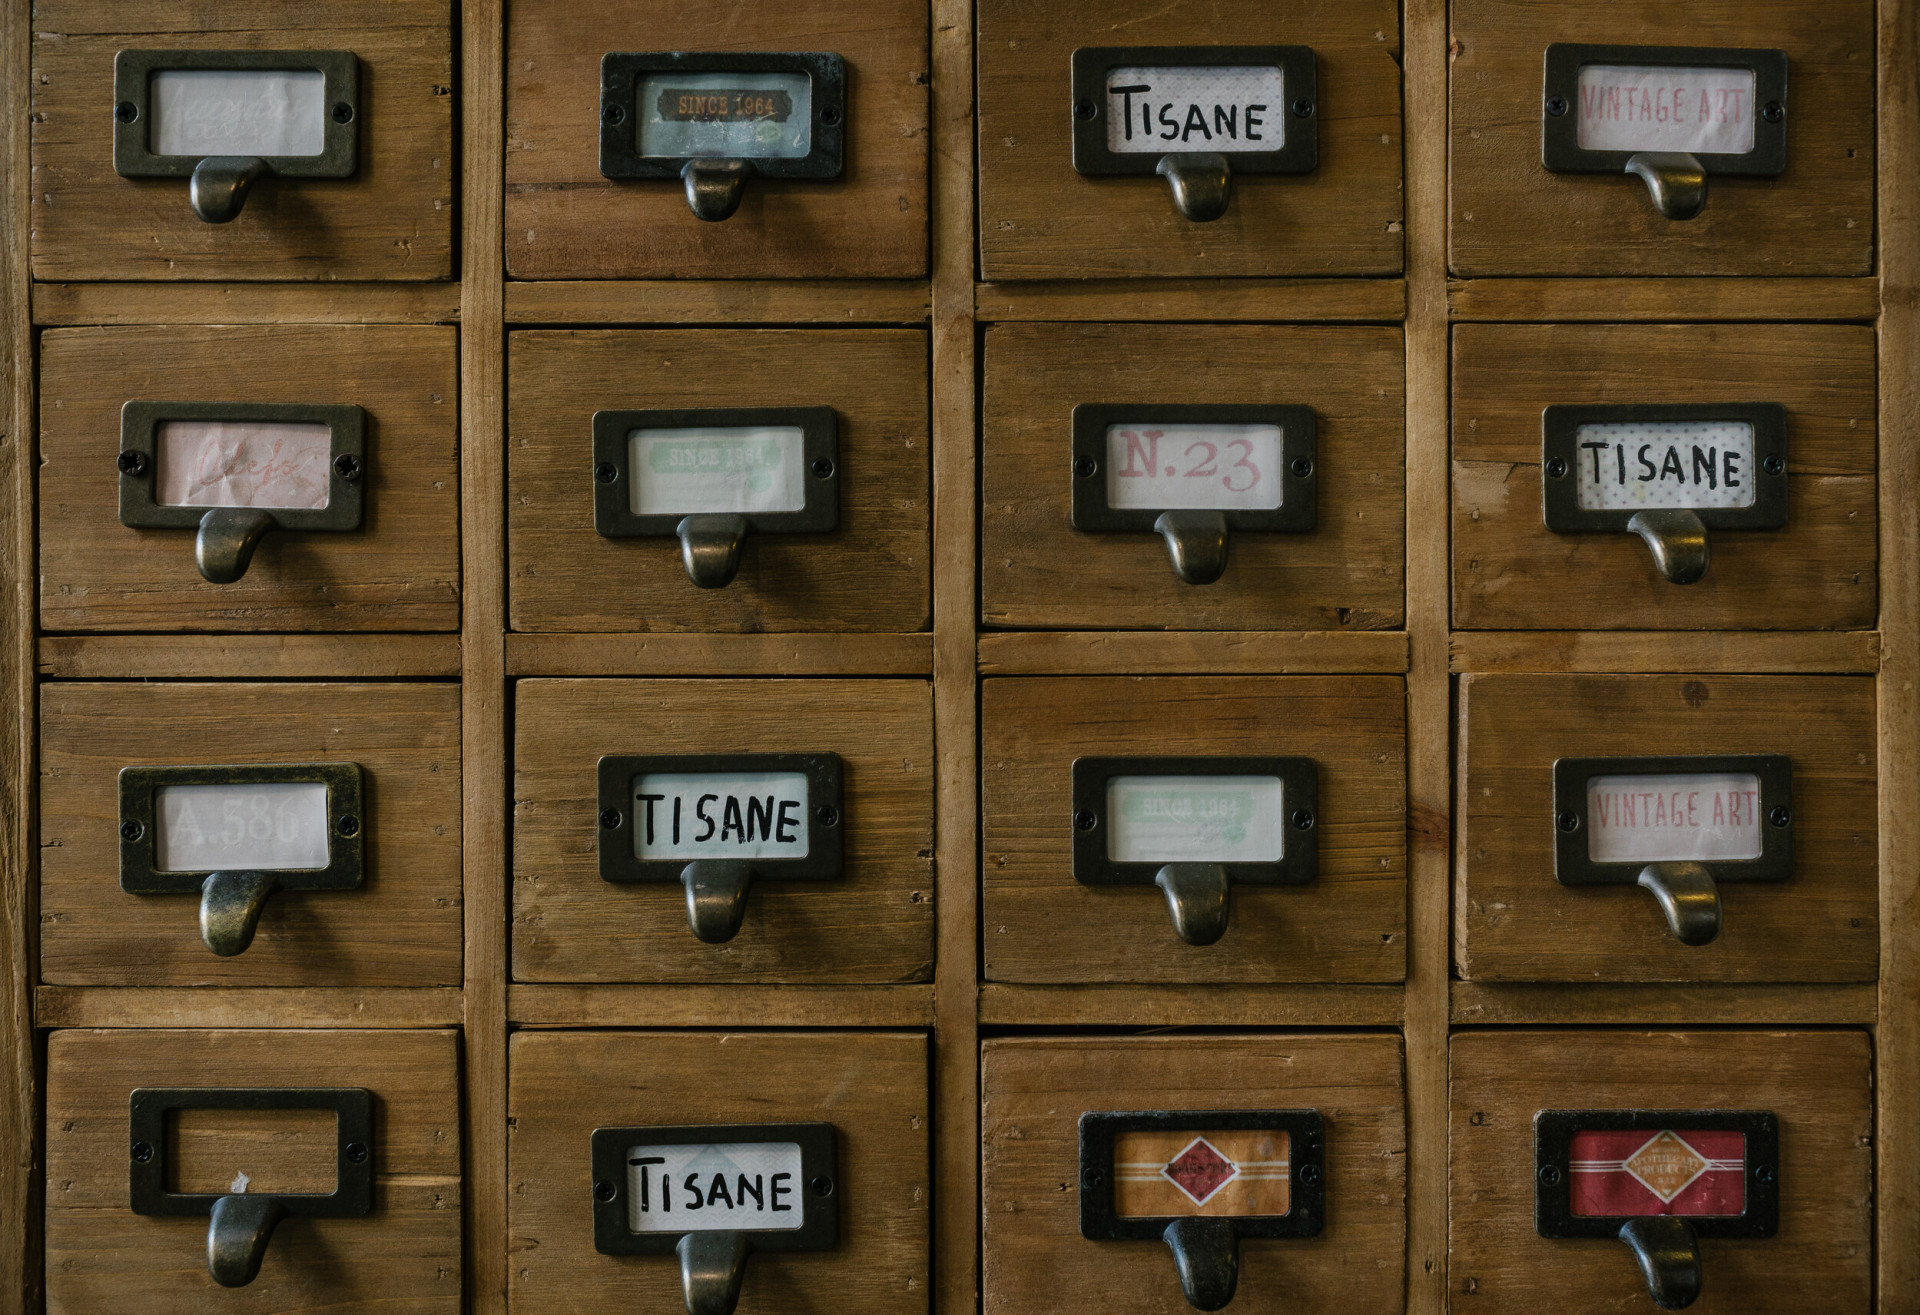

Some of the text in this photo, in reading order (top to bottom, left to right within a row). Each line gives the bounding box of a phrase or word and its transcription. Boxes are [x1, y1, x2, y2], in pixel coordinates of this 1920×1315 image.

[678, 95, 774, 116] SINCE 1964
[1109, 84, 1267, 142] TISANE
[1582, 84, 1746, 124] VINTAGE ART
[669, 447, 719, 466] SINCE
[1118, 430, 1261, 492] N.23
[1580, 442, 1742, 490] TISANE
[636, 793, 801, 846] TISANE
[1597, 790, 1757, 828] VINTAGE ART
[629, 1156, 792, 1213] TISANE
